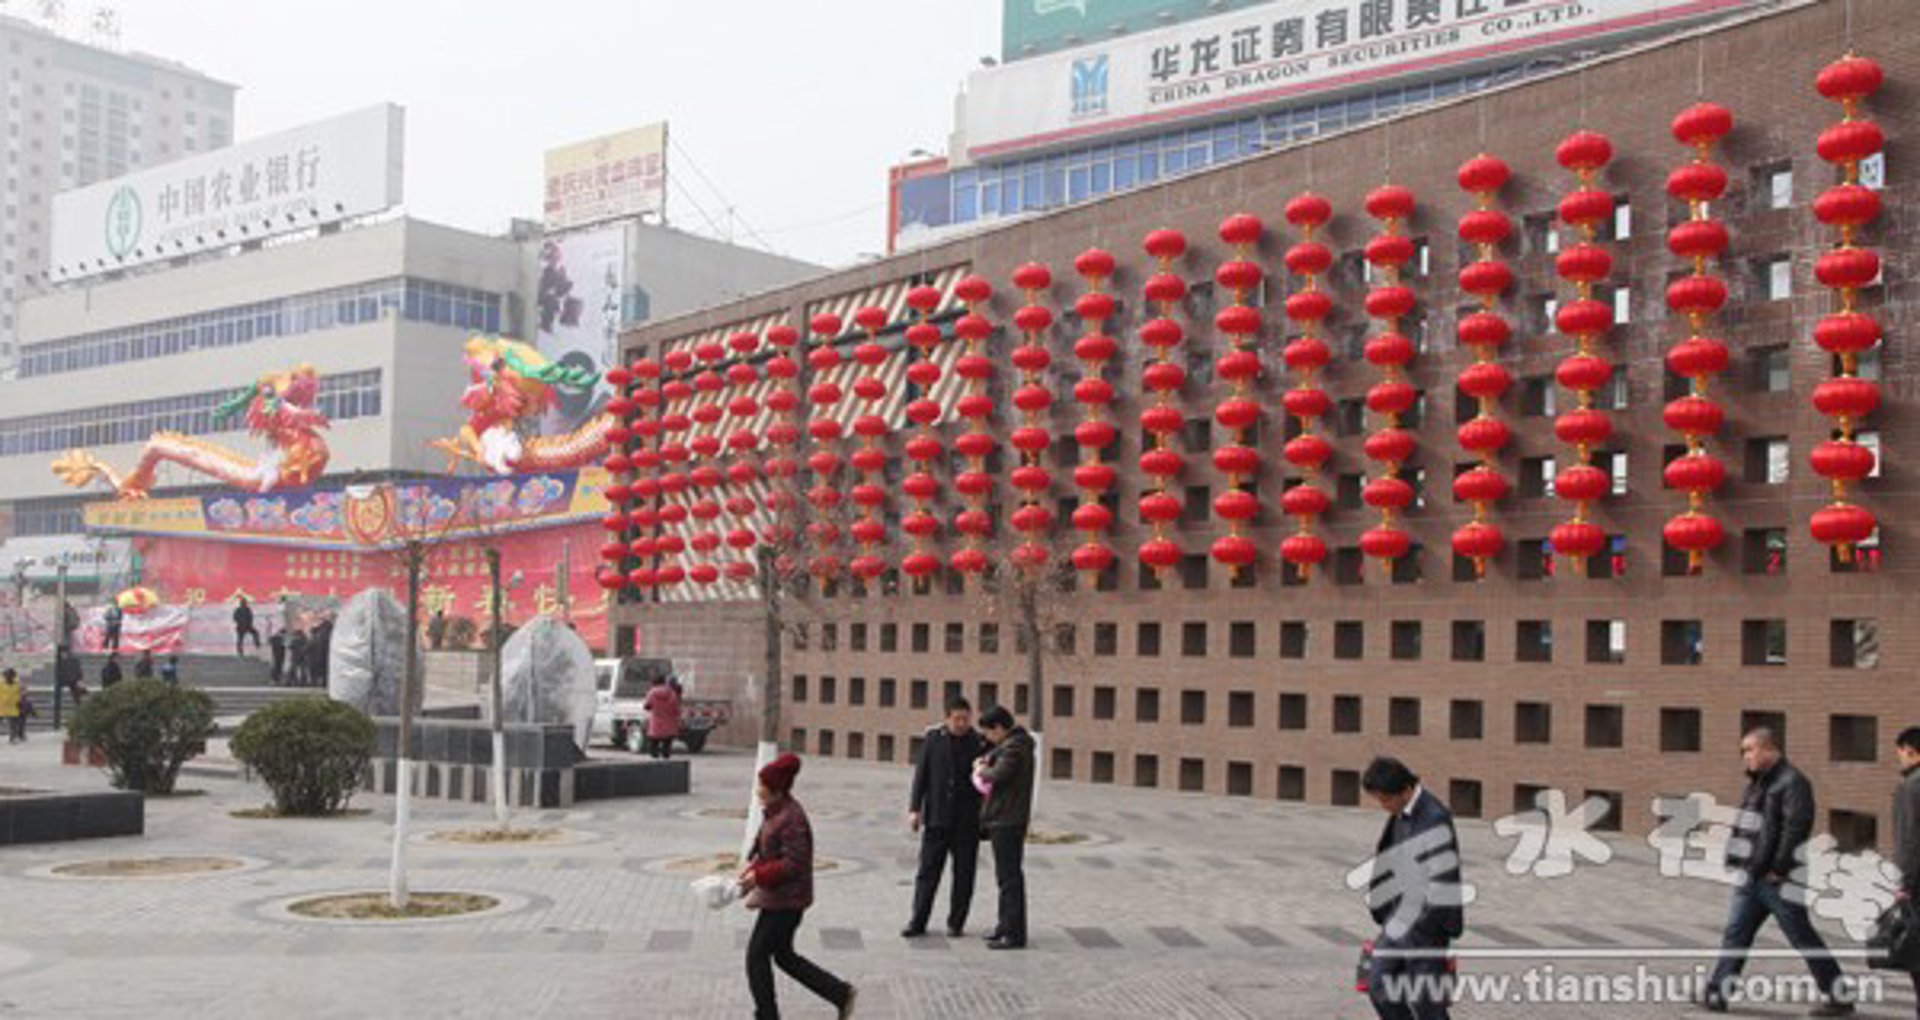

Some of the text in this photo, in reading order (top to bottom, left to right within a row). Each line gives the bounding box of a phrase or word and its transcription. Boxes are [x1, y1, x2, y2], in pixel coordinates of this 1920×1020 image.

[1151, 0, 1530, 81] 华龙证券有限责
[1151, 82, 1212, 103] CHINA
[1225, 60, 1310, 90] DRAGON
[1328, 28, 1460, 68] SECURITIES
[158, 145, 320, 224] 中国农业银行
